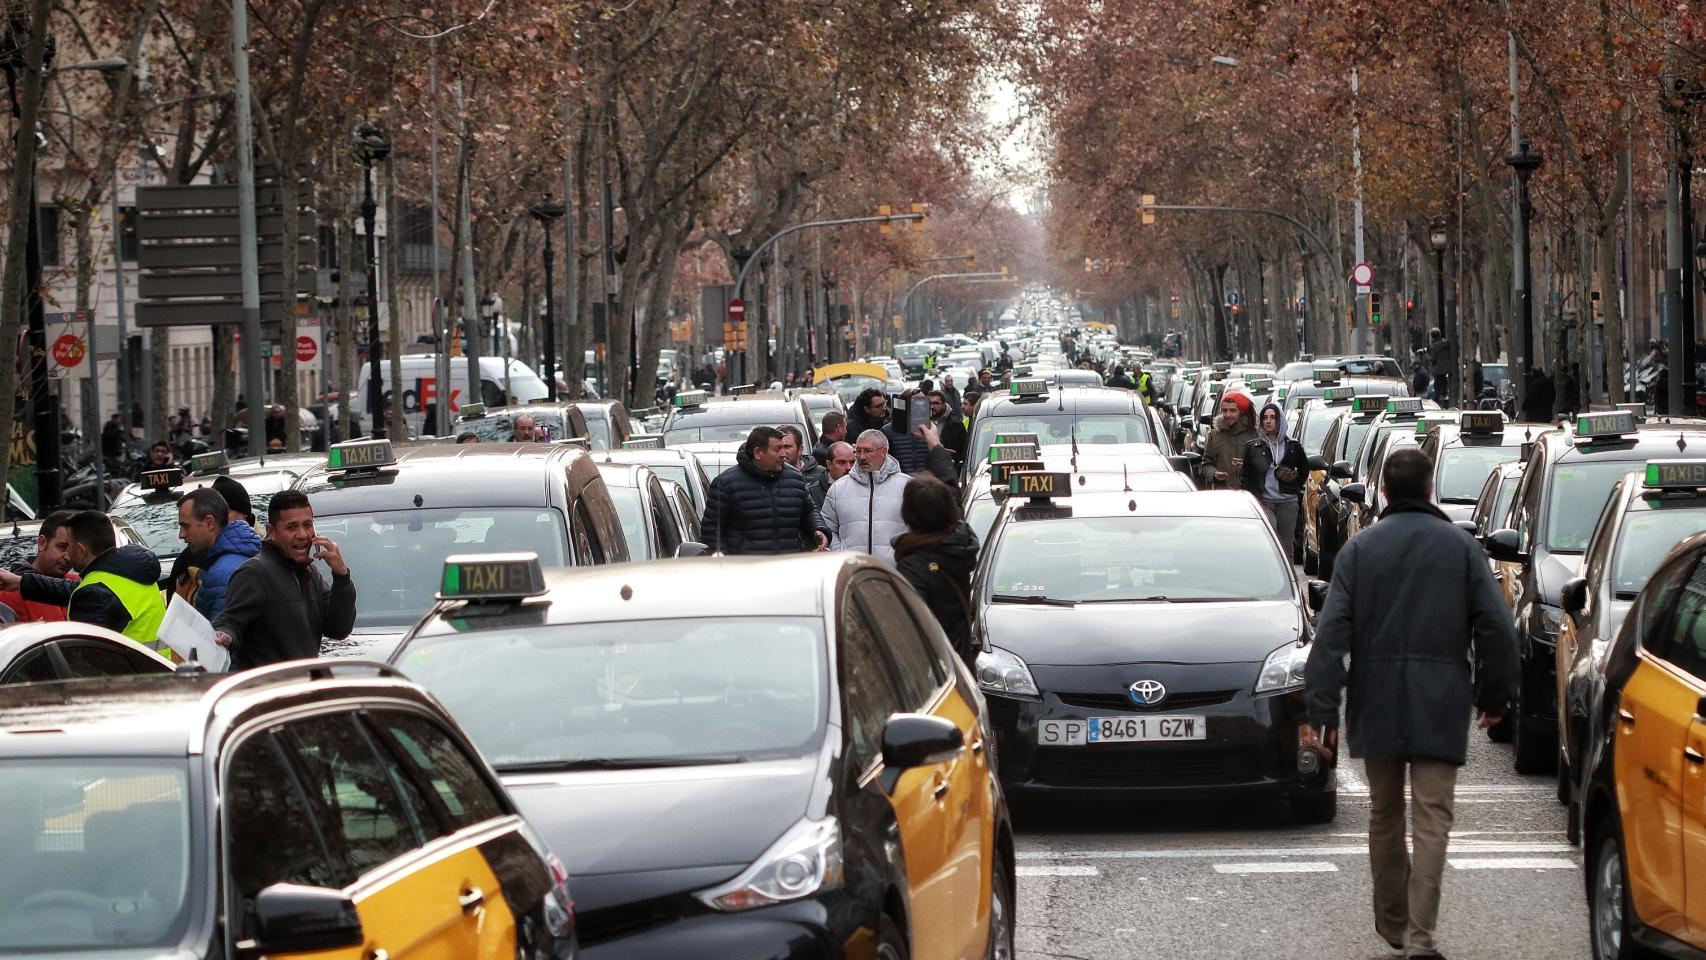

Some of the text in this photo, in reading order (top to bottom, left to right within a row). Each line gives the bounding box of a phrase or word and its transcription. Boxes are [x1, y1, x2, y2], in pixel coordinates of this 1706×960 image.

[1363, 399, 1379, 410] TAXI
[1472, 416, 1491, 429] TAXI
[1592, 418, 1616, 432] TAXI
[344, 446, 372, 465] TAXI
[1000, 447, 1022, 461] TAXI
[147, 473, 169, 486] TAXI
[1663, 466, 1690, 481] TAXI
[1022, 475, 1053, 492] TAXI
[463, 564, 505, 591] TAXI
[1101, 718, 1195, 739] 8461 GZW
